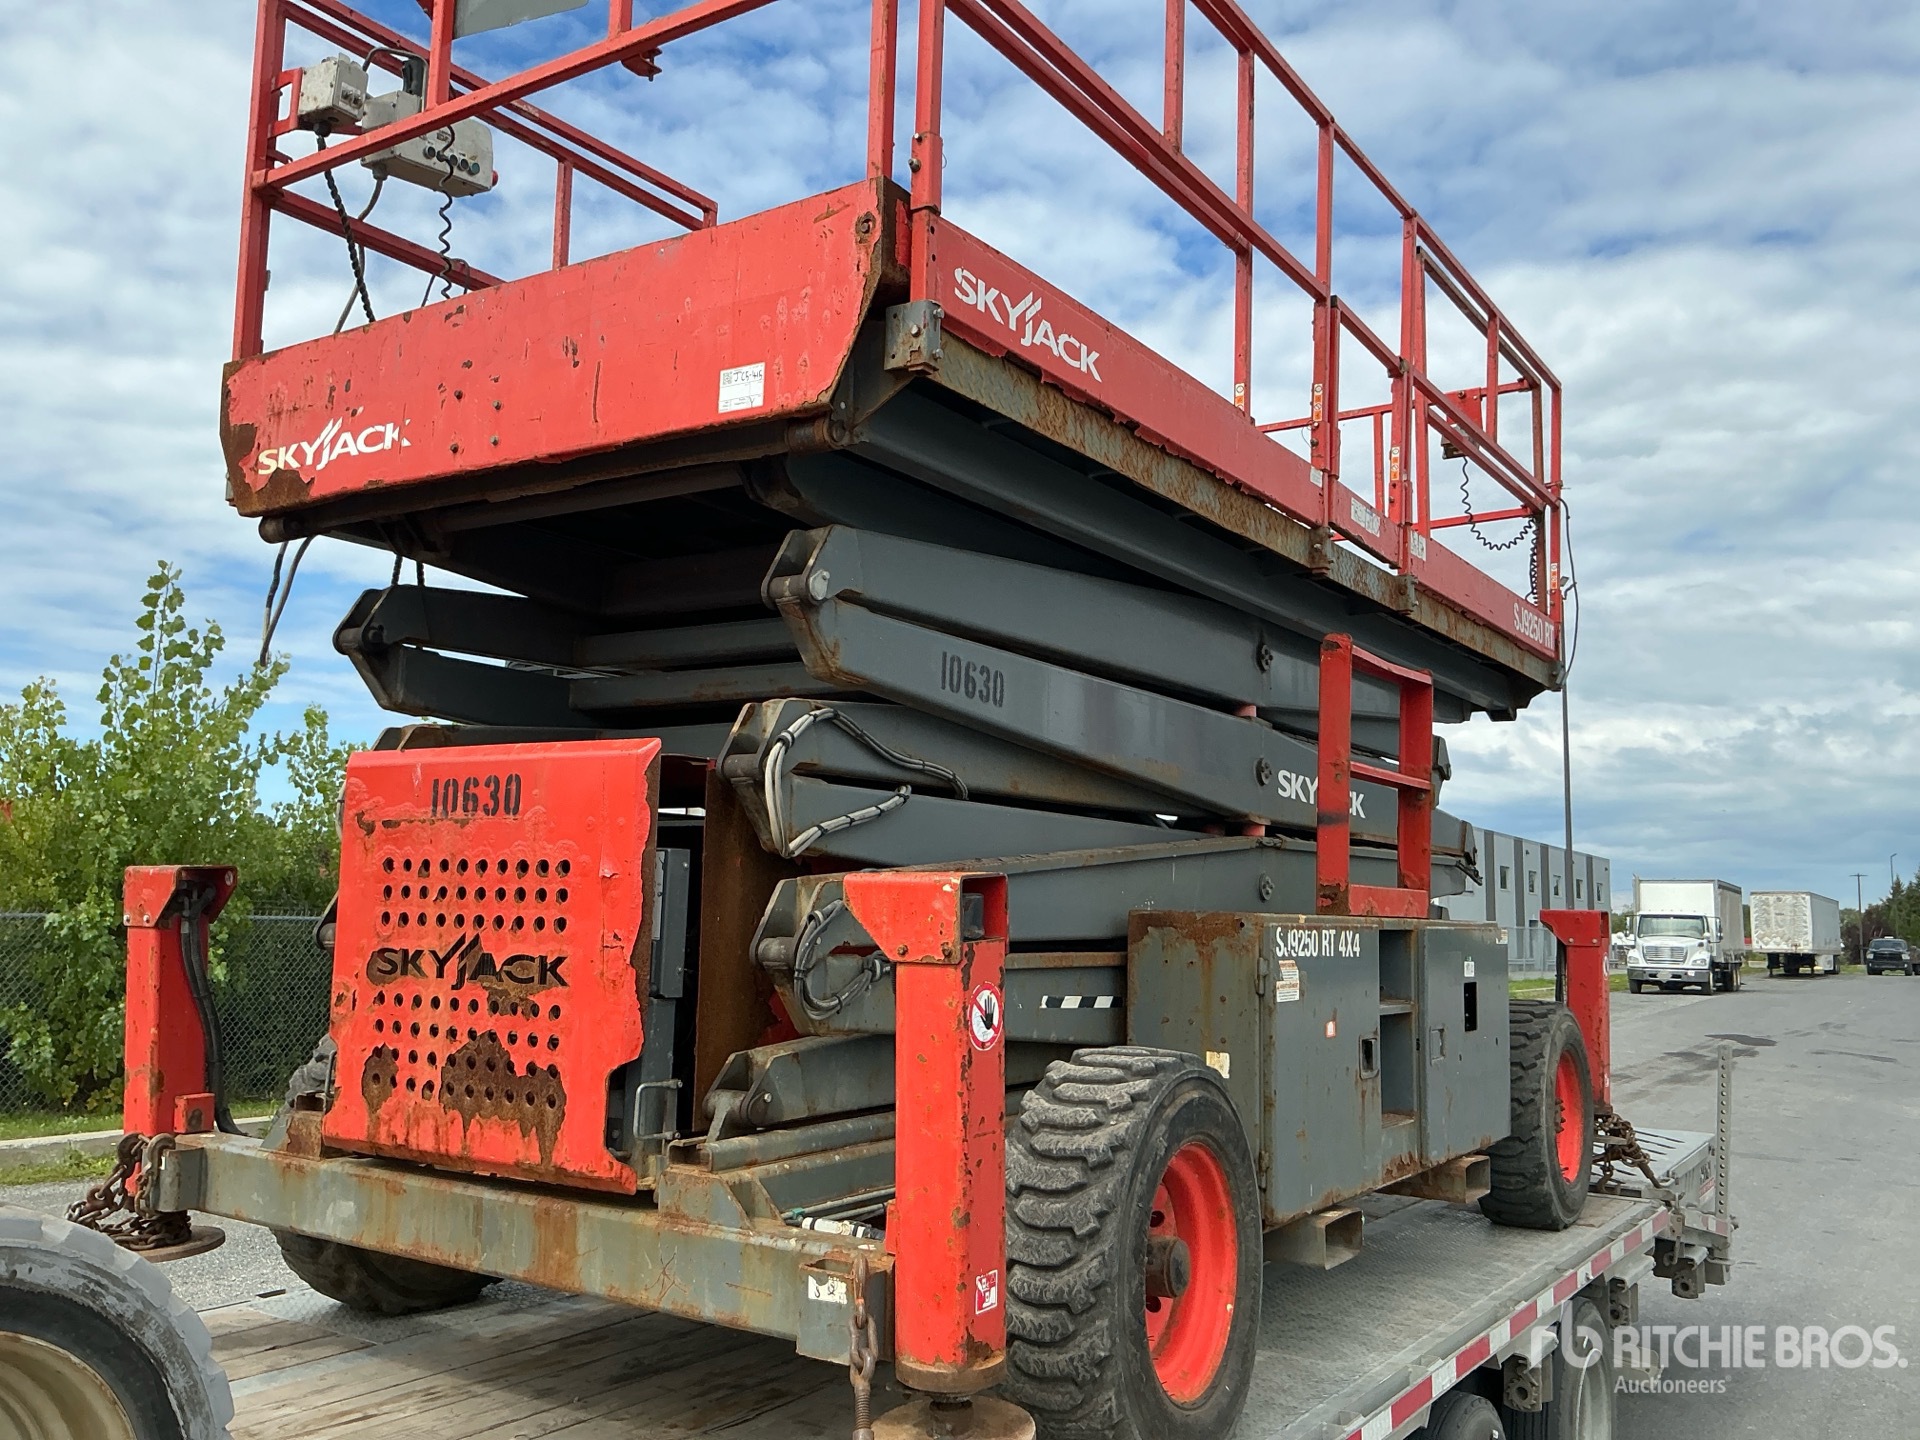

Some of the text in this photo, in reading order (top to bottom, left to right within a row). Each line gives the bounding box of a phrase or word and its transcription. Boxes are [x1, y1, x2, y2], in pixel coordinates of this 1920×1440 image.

[954, 266, 1103, 384] SKYJACK
[257, 416, 412, 475] SKYJACK
[1513, 602, 1555, 651] SJ9250 RT
[941, 651, 1004, 708] 10630
[431, 773, 522, 818] 10630
[1277, 769, 1366, 819] SKYK
[376, 932, 570, 991] SKYJACK
[1275, 926, 1361, 958] SJ9250 RT 4X4
